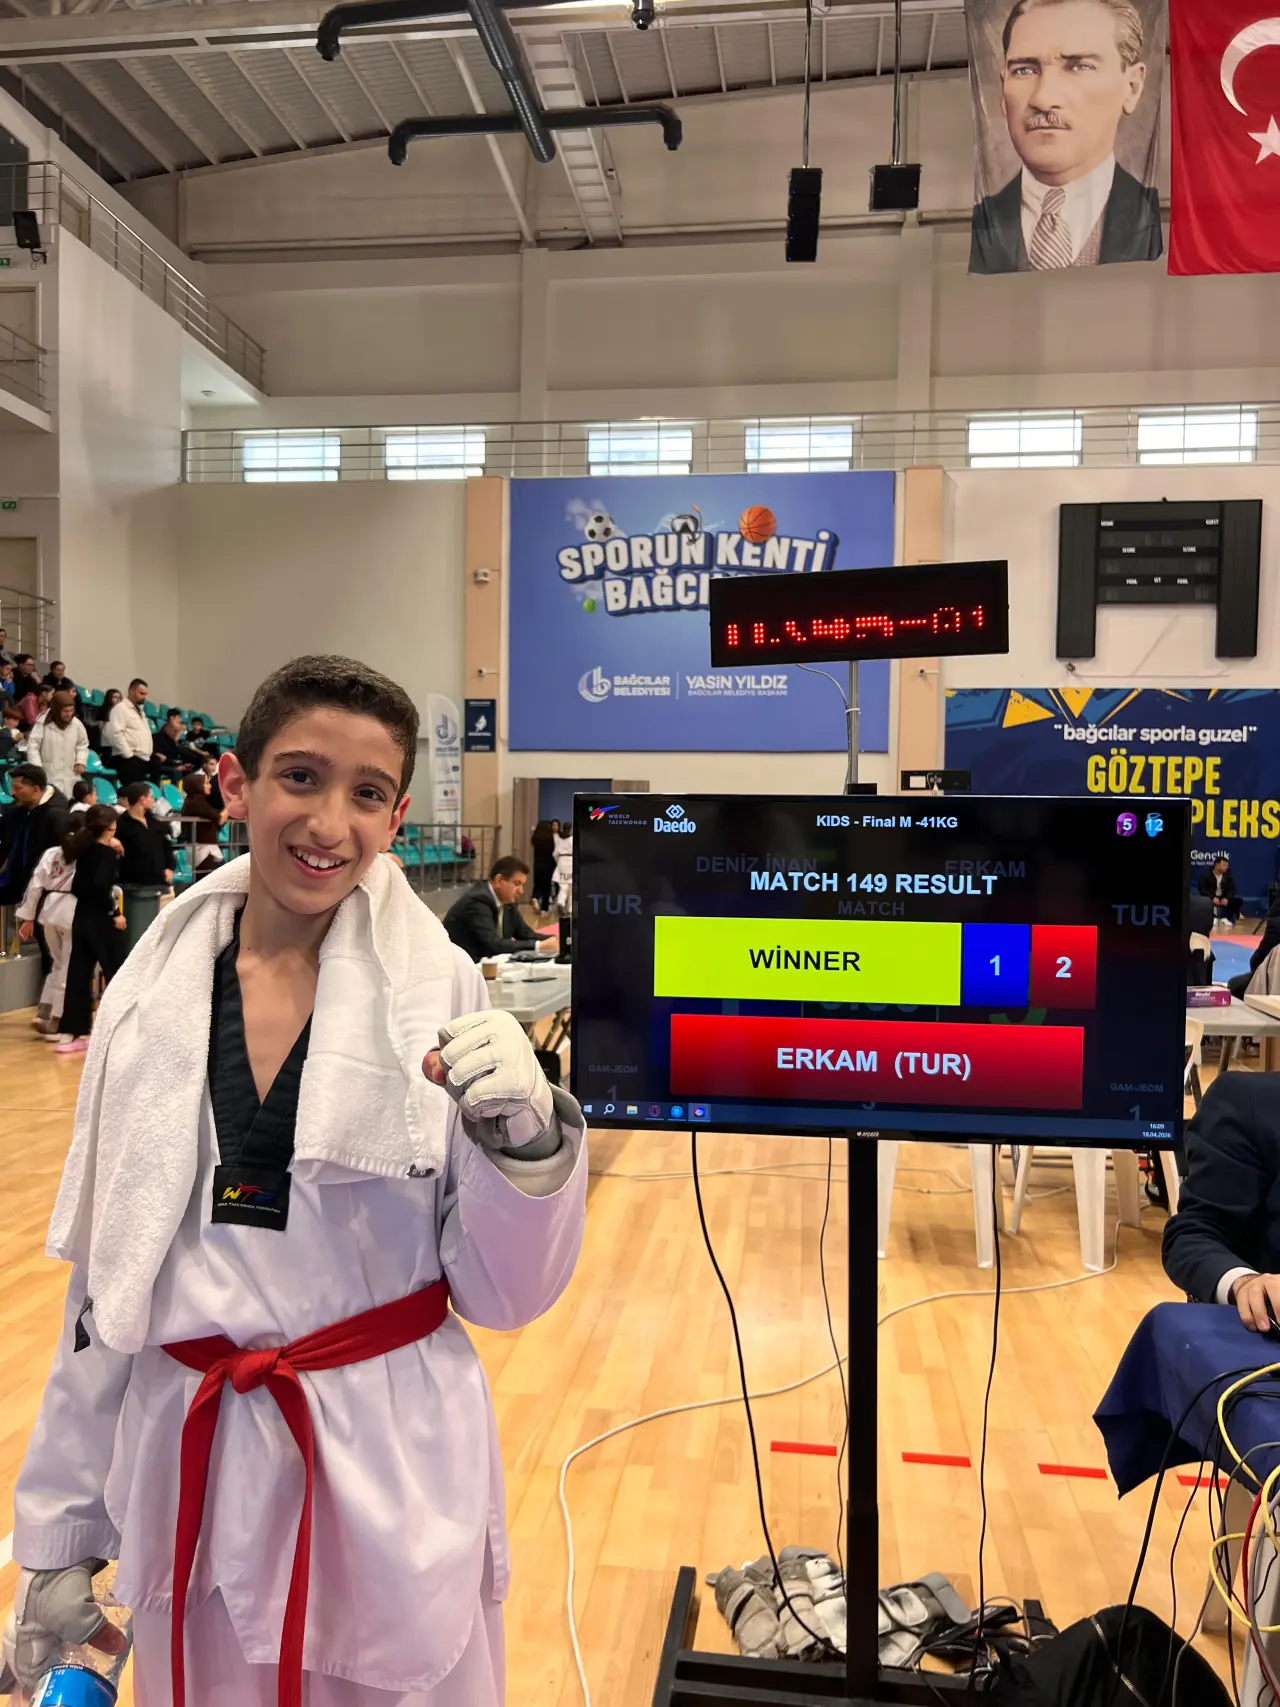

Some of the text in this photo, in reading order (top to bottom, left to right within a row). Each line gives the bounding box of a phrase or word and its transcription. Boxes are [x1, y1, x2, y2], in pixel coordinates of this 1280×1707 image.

[558, 530, 830, 580] SPORUN KENTİ
[604, 569, 710, 612] BAĞCI
[613, 674, 670, 686] BAĞCILAR
[685, 675, 788, 689] YASİN YILDIZ
[1140, 725, 1196, 744] sporla
[1087, 748, 1221, 794] GÖZTEPE
[653, 817, 697, 833] Daedo
[816, 815, 850, 827] KIDS
[862, 815, 895, 828] Final
[900, 816, 912, 828] M
[915, 816, 958, 829] -41KG
[1122, 818, 1133, 831] 5
[1145, 818, 1164, 832] 12
[696, 853, 818, 873] DENİZ İNAN
[945, 860, 1027, 878] ERKAM
[750, 872, 998, 895] MATCH 149 RESULT
[588, 894, 642, 915] TUR
[837, 901, 905, 916] MATCH
[1111, 904, 1172, 927] TUR
[749, 945, 861, 972] WİNNER
[989, 955, 1001, 976] 1
[1055, 957, 1072, 978] 2
[588, 1064, 639, 1074] GAM-JEOM
[776, 1048, 971, 1080] ERKAM (TUR)
[1109, 1082, 1164, 1093] GAM-JEOM
